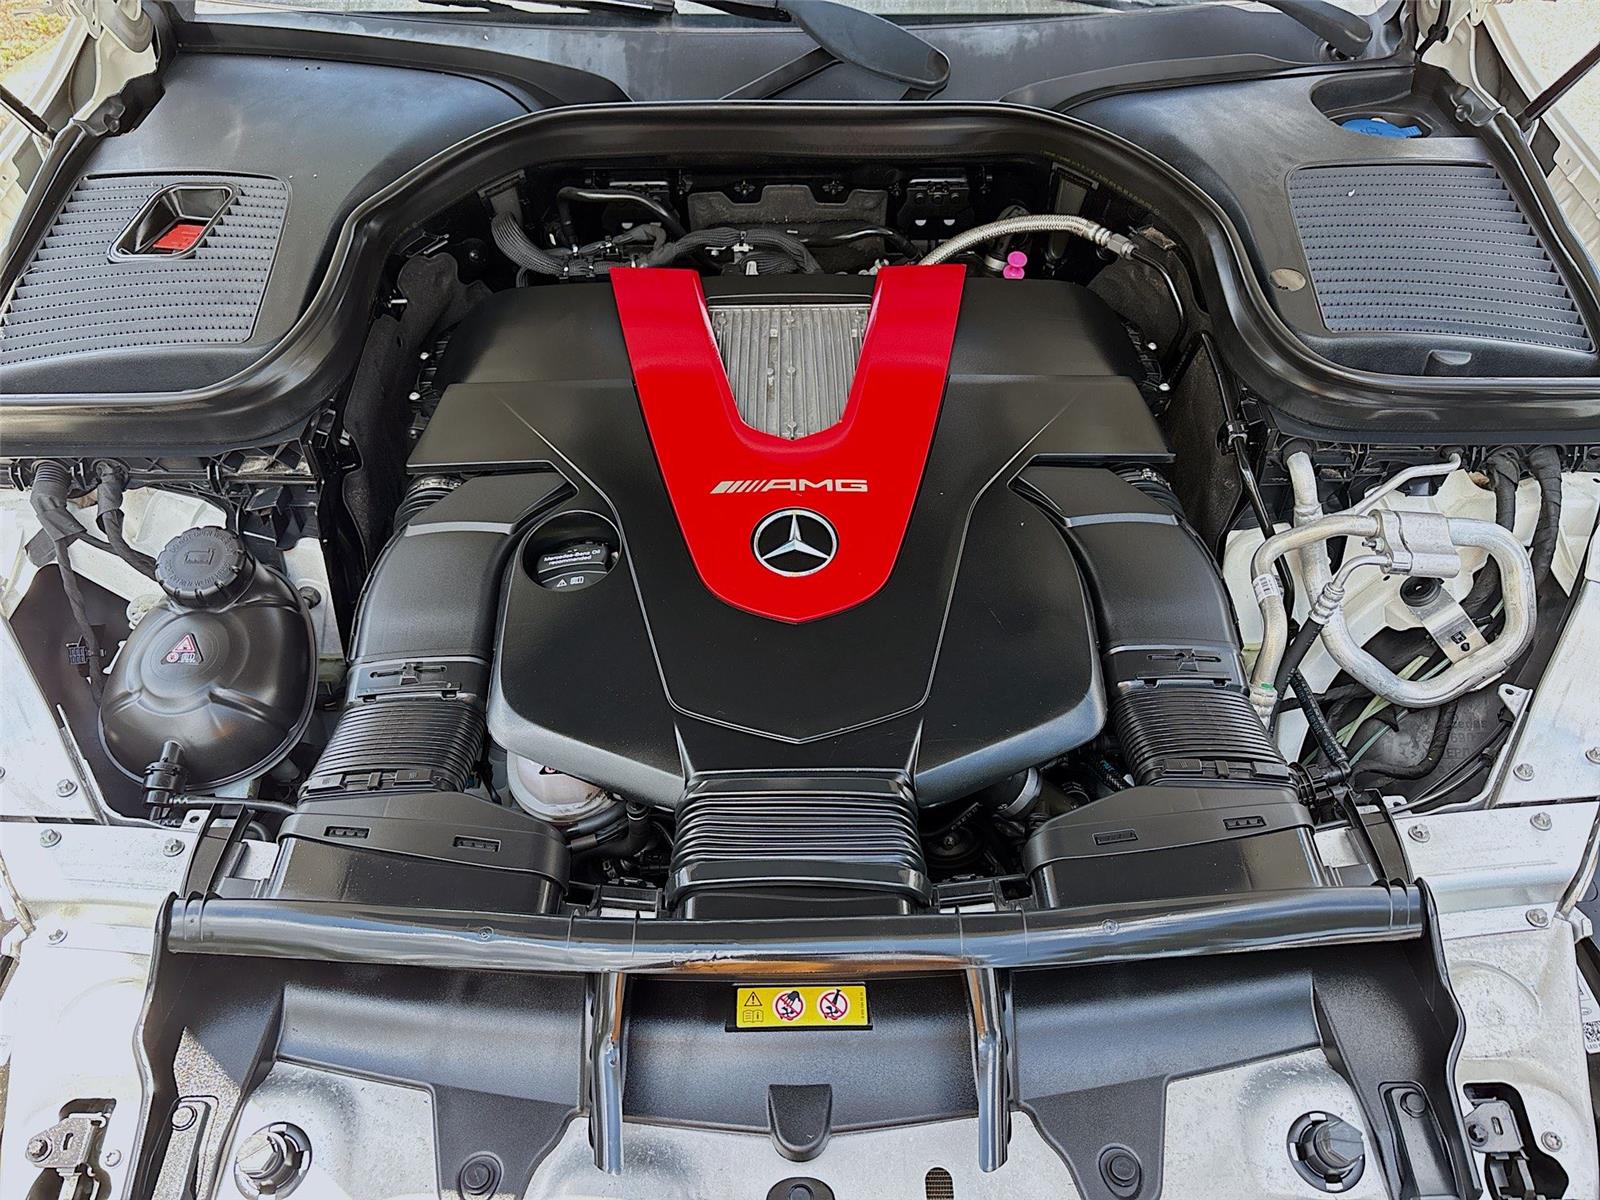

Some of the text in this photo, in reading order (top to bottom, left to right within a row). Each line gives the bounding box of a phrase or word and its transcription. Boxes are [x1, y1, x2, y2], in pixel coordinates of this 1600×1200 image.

[760, 478, 869, 493] AMG
[543, 551, 591, 561] Mercedes-Benz
[548, 555, 592, 565] recommended
